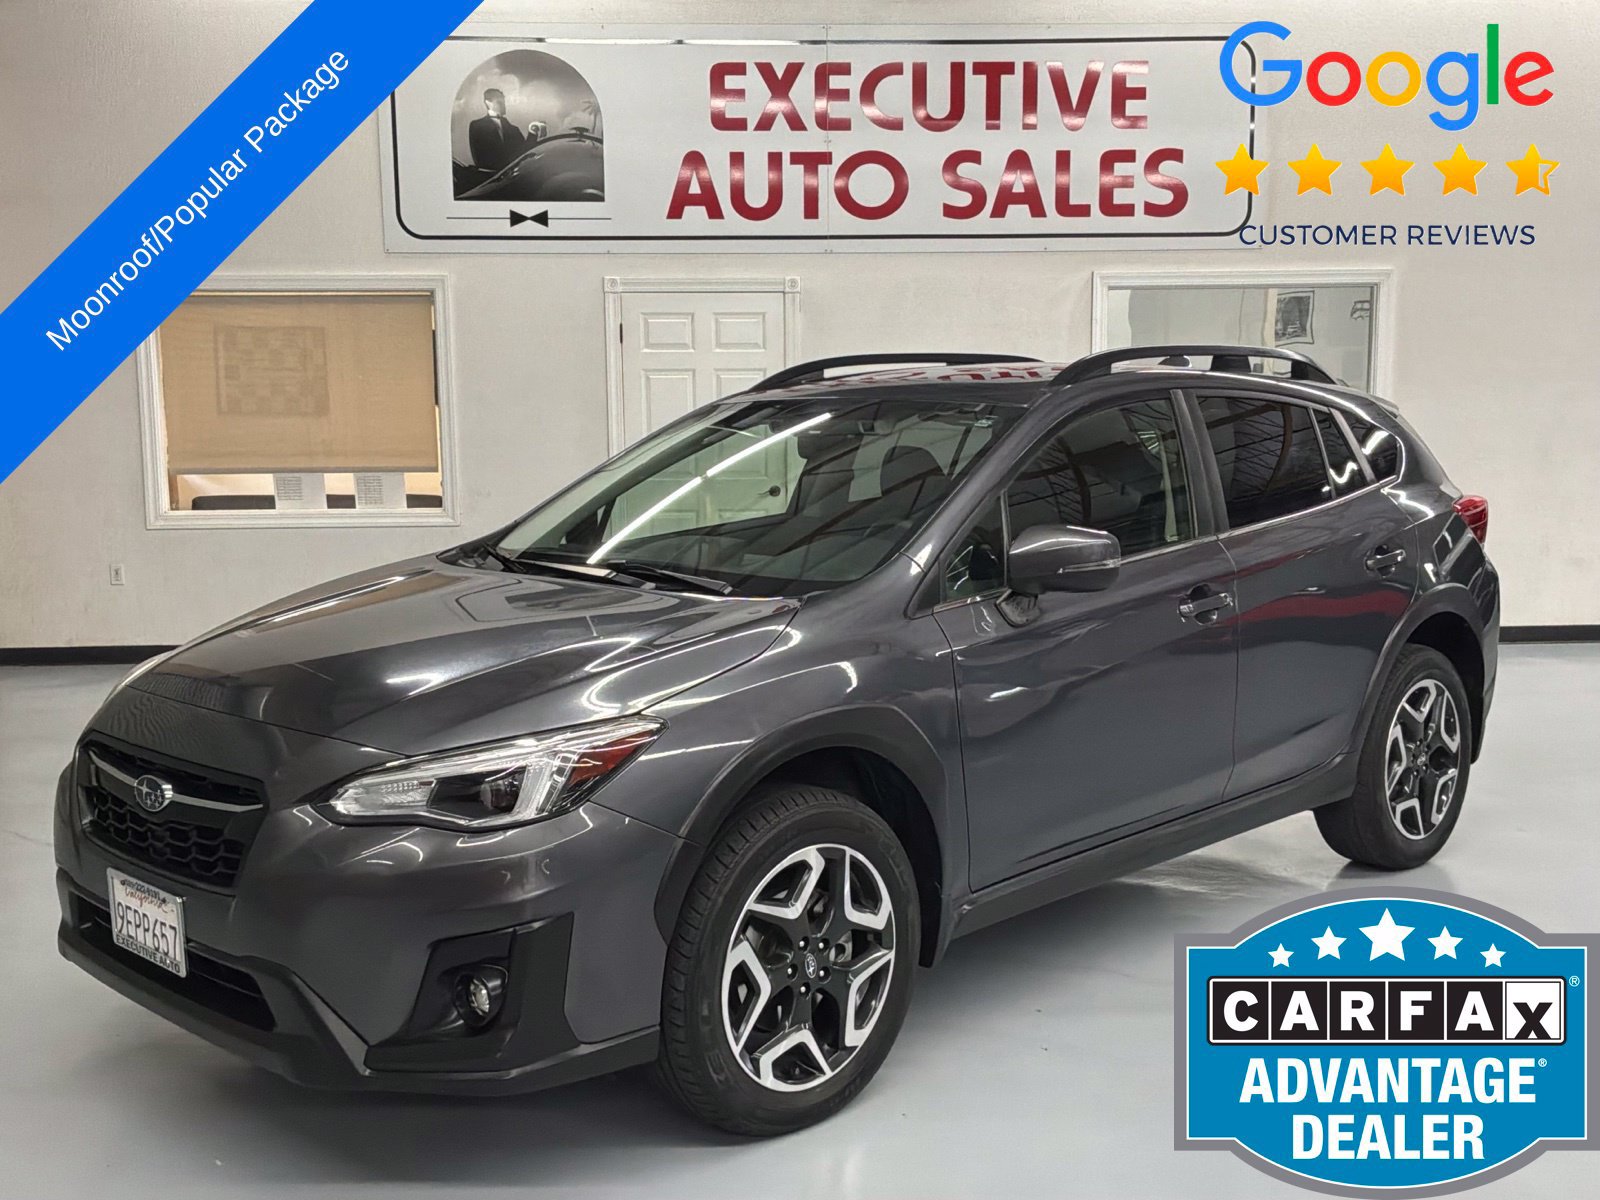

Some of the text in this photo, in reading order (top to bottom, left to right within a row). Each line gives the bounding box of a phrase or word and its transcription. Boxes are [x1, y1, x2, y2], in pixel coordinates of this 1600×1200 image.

[708, 60, 1149, 132] EXECUTIVE
[665, 147, 1189, 221] AUTO SALES
[116, 934, 181, 974] EXECUTIVE AUTO
[117, 901, 178, 961] 9EPP657
